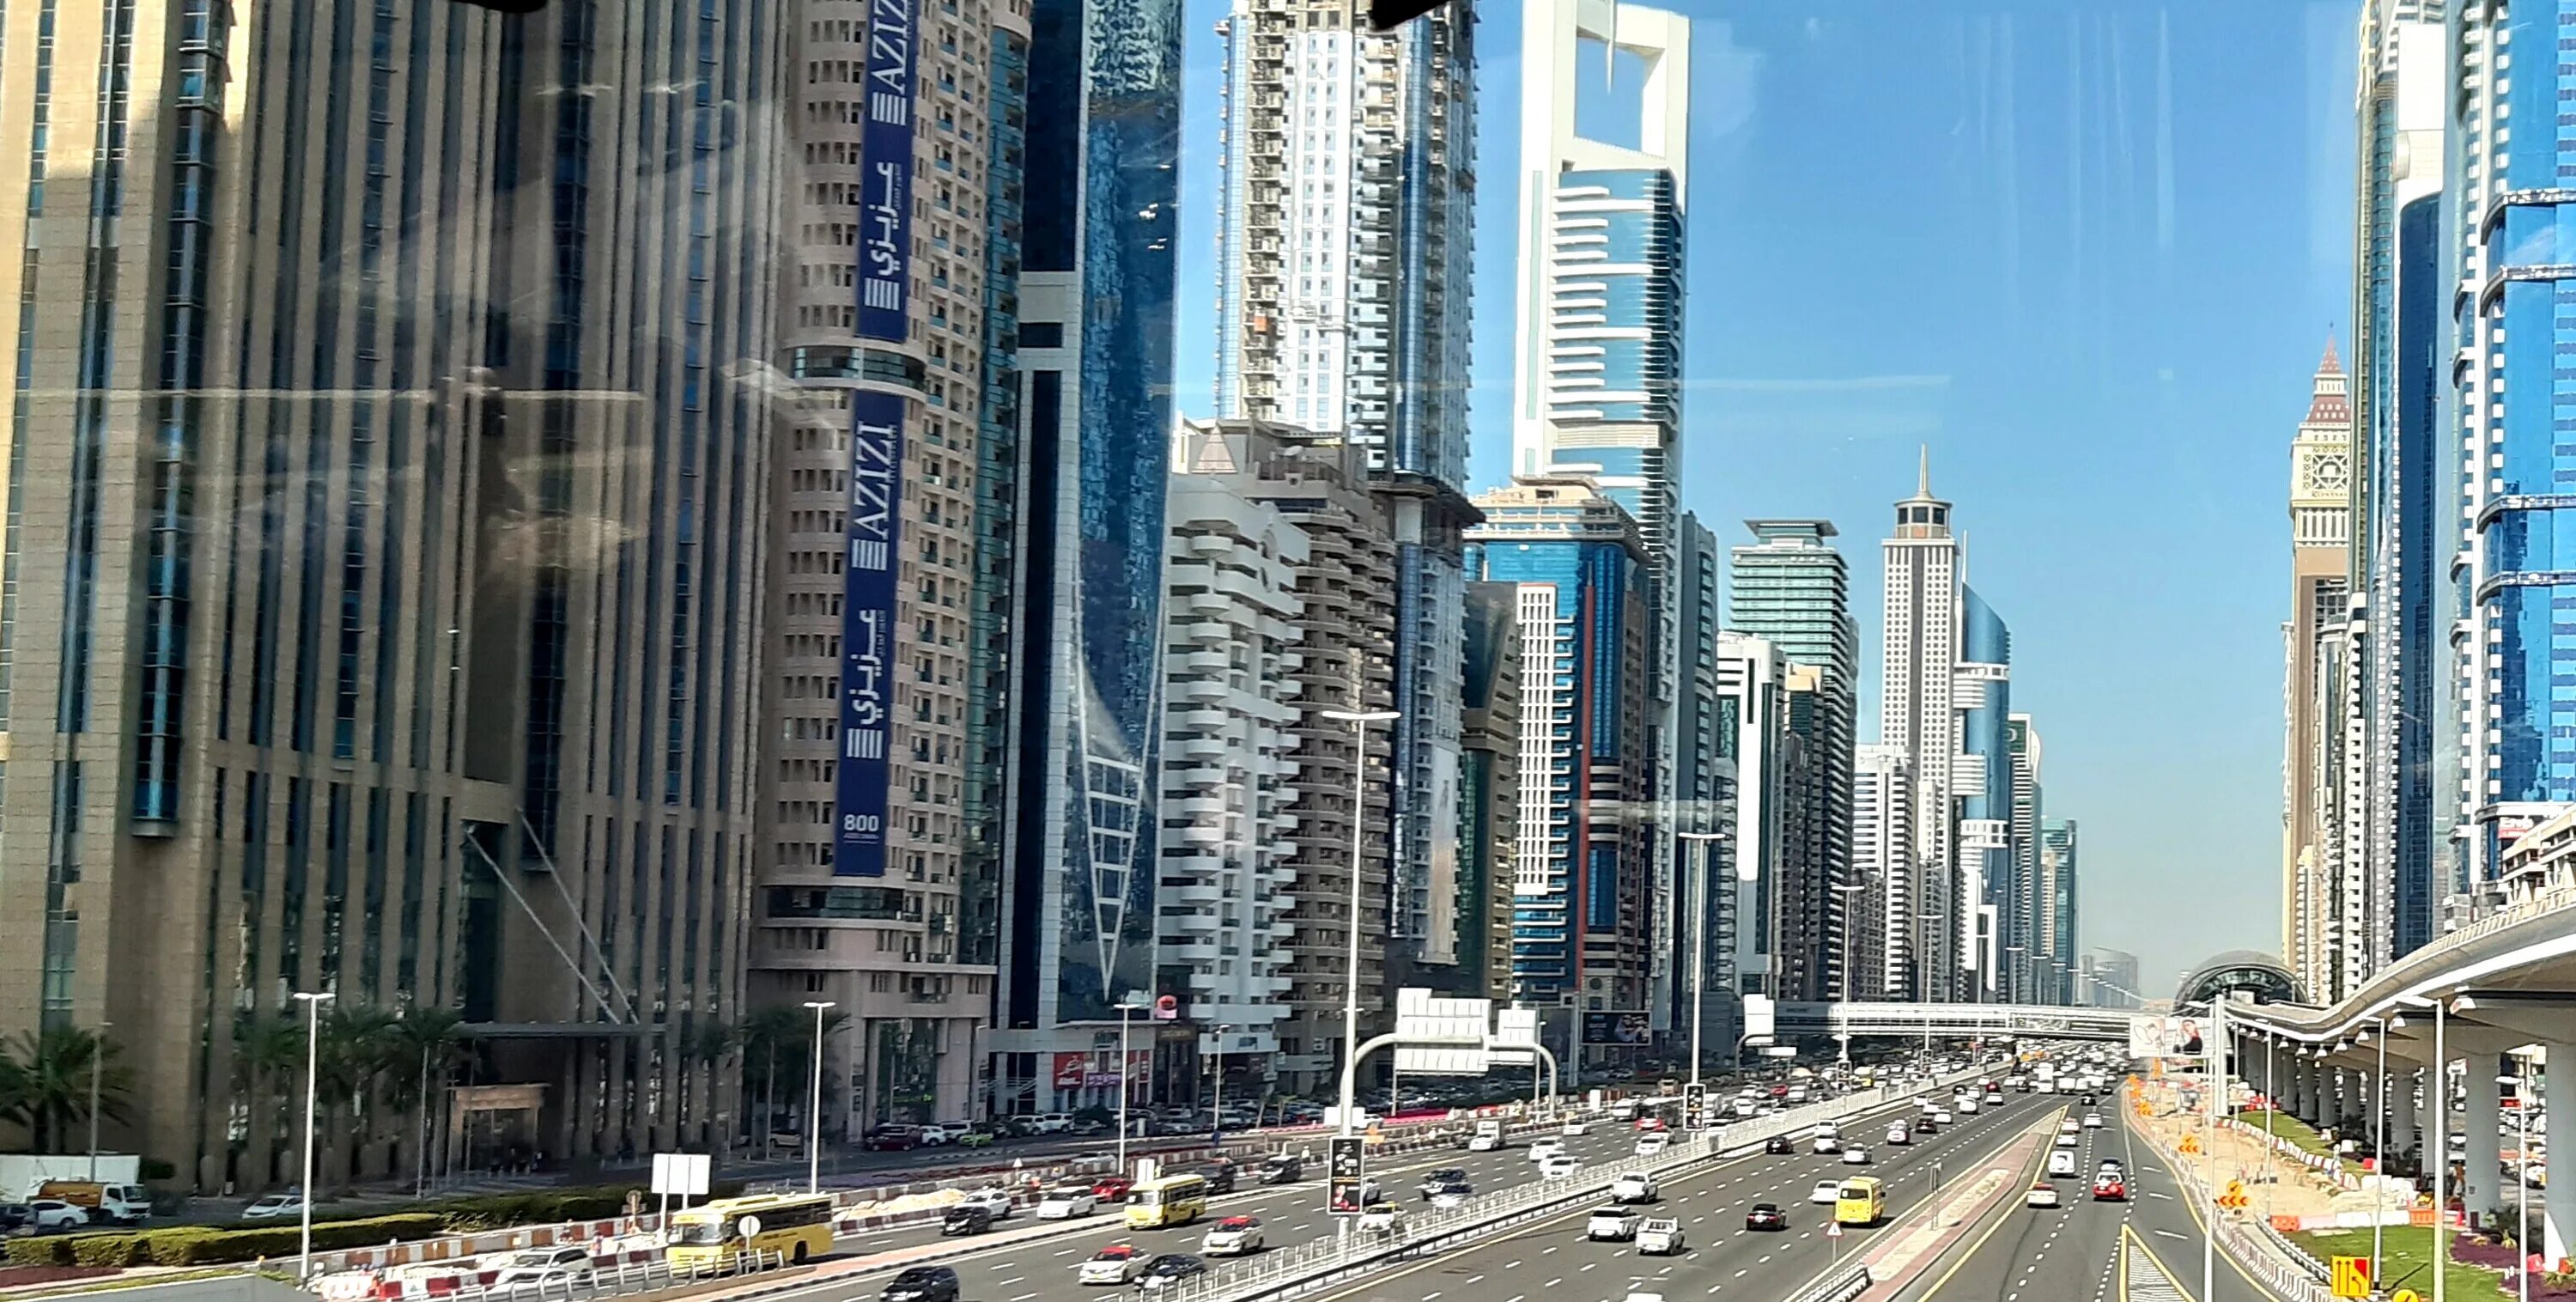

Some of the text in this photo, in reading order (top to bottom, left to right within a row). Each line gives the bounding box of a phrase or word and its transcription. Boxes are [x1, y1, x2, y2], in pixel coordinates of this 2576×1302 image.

[866, 161, 901, 276] عزيزي
[854, 420, 893, 541] AZIZI
[848, 609, 884, 725] عزيزي
[844, 814, 879, 831] 800
